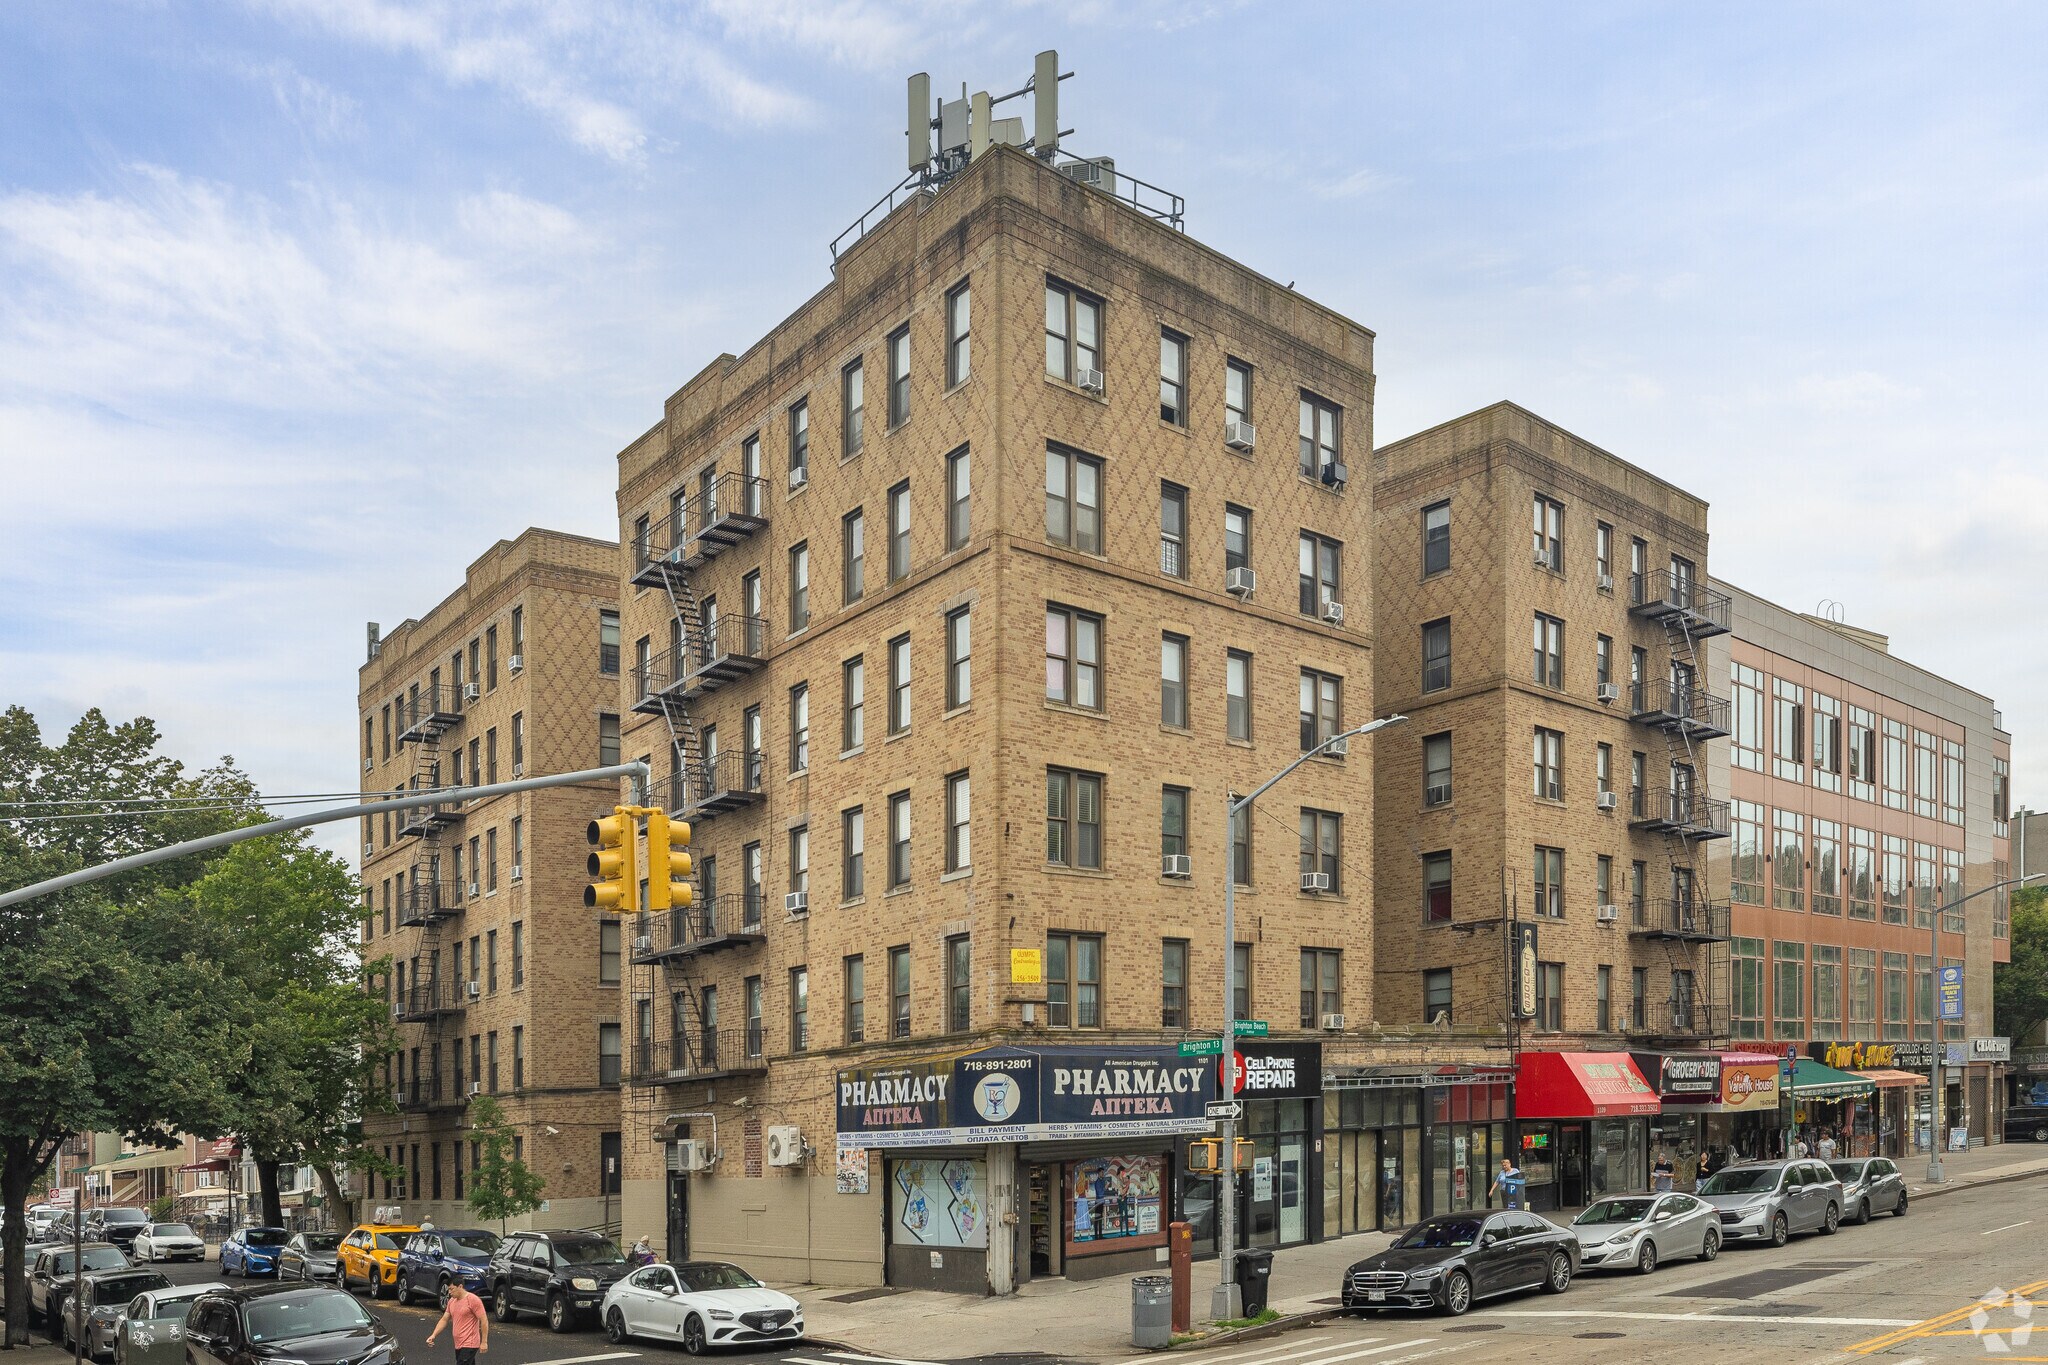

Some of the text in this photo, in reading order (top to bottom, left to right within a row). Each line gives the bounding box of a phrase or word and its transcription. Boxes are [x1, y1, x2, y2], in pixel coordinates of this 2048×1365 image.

[1235, 1022, 1267, 1031] Brighton Beach
[1183, 1041, 1211, 1052] Brighton
[964, 1059, 1032, 1071] 718-891-2801
[1245, 1056, 1295, 1070] CELL PHONE
[1902, 1056, 1922, 1066] PHYSICAL
[1672, 1061, 1700, 1078] GROCERY
[1705, 1061, 1720, 1078] DELI
[1054, 1068, 1204, 1095] PHARMACY
[1246, 1070, 1295, 1090] REPAIR
[1728, 1079, 1753, 1096] Varenyk
[1755, 1078, 1773, 1092] House
[841, 1074, 949, 1106] PHARMACY
[1091, 1097, 1173, 1115] АПТЕКА
[1209, 1106, 1237, 1115] ONE WAY
[863, 1106, 923, 1125] АПТЕКА
[1511, 1185, 1516, 1193] P
